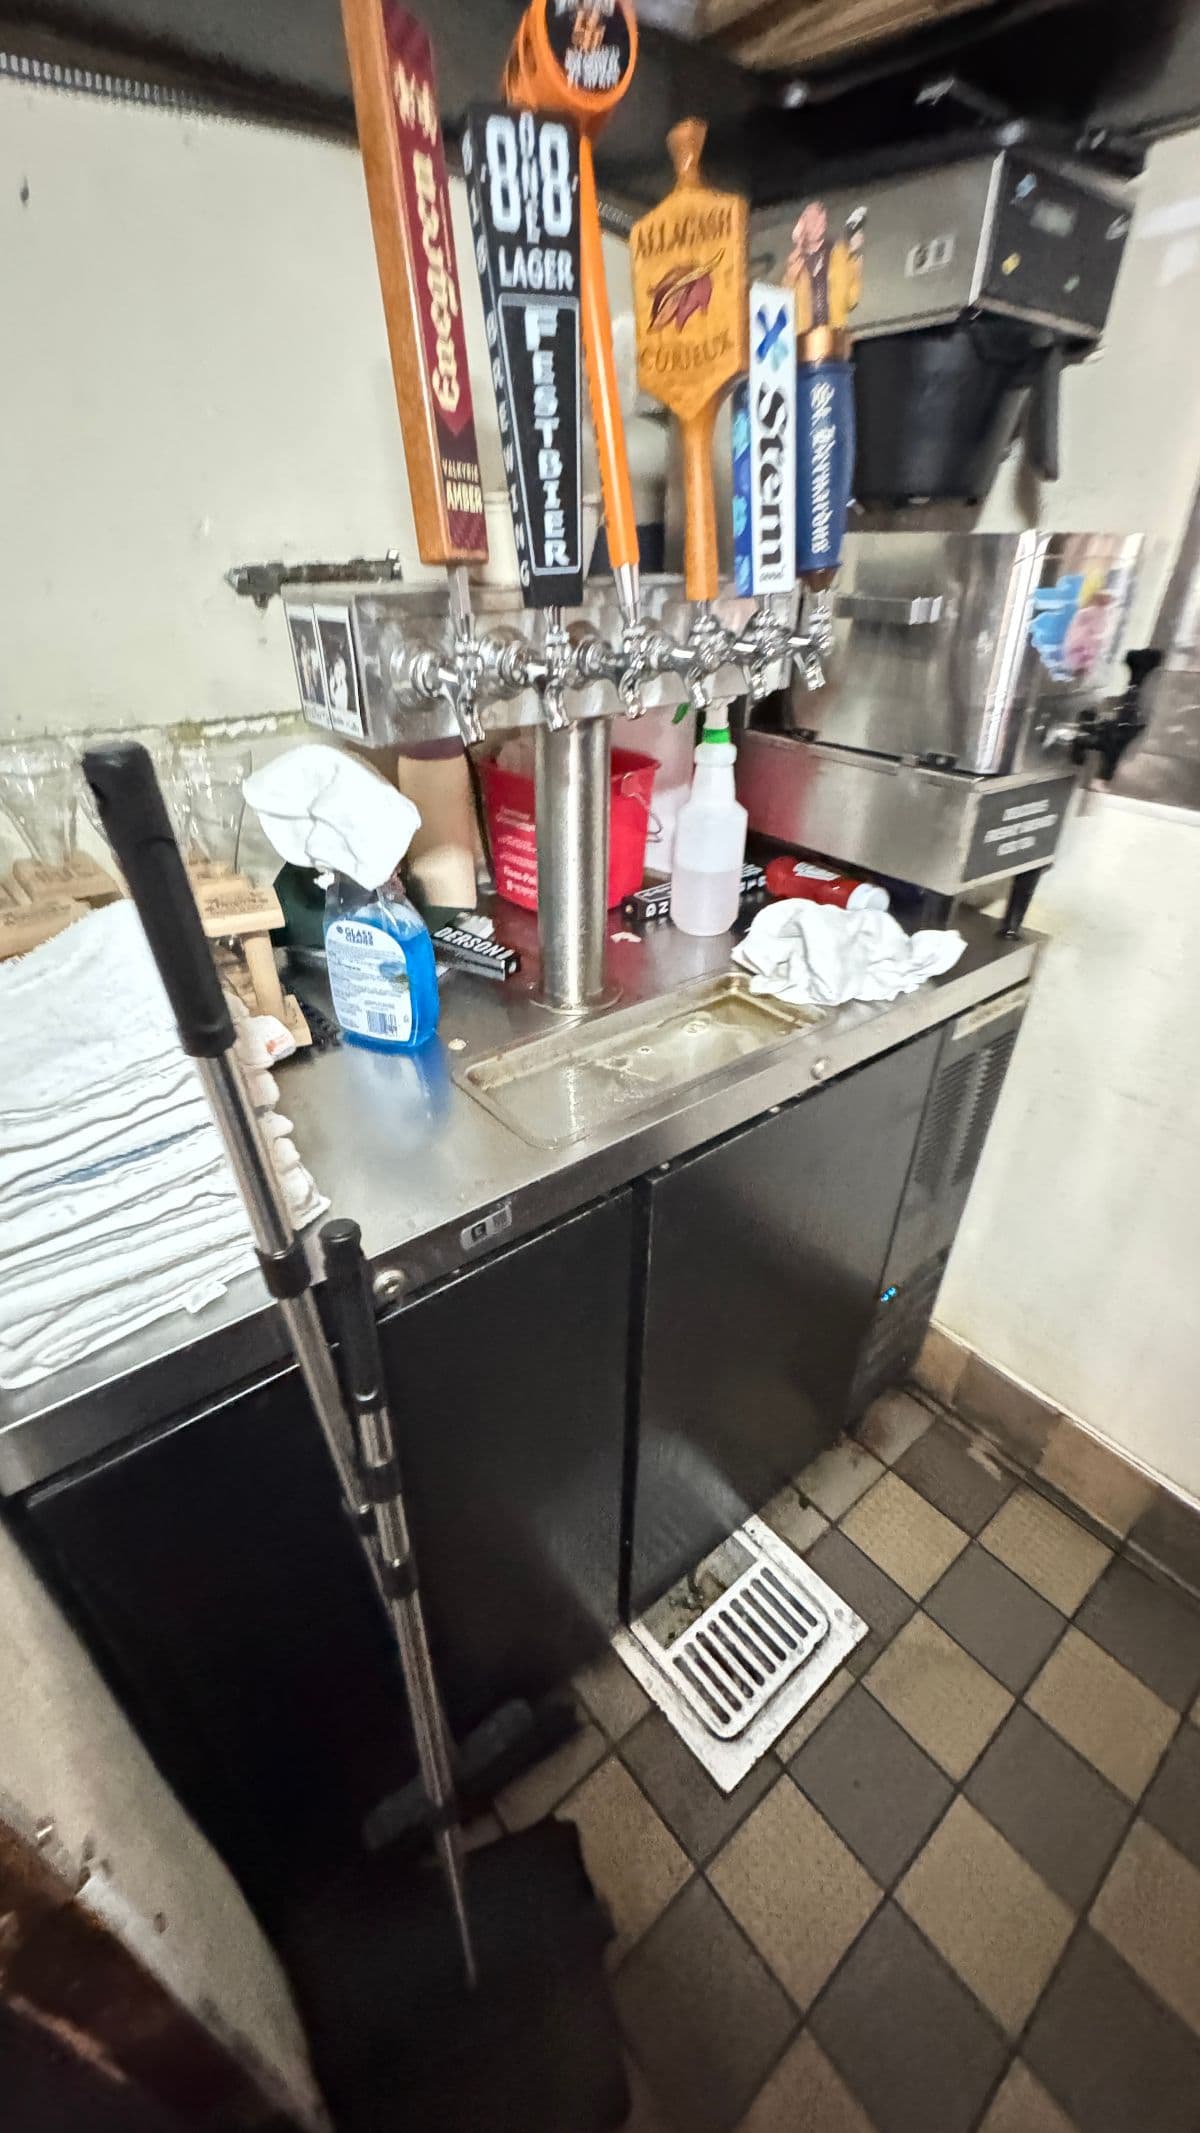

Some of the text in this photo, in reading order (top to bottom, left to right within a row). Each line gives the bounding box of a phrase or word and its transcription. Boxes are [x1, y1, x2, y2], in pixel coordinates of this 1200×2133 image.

[499, 245, 575, 291] LAGER
[639, 328, 734, 373] CURIEUX
[446, 480, 483, 513] AMBER
[758, 383, 788, 566] Stem
